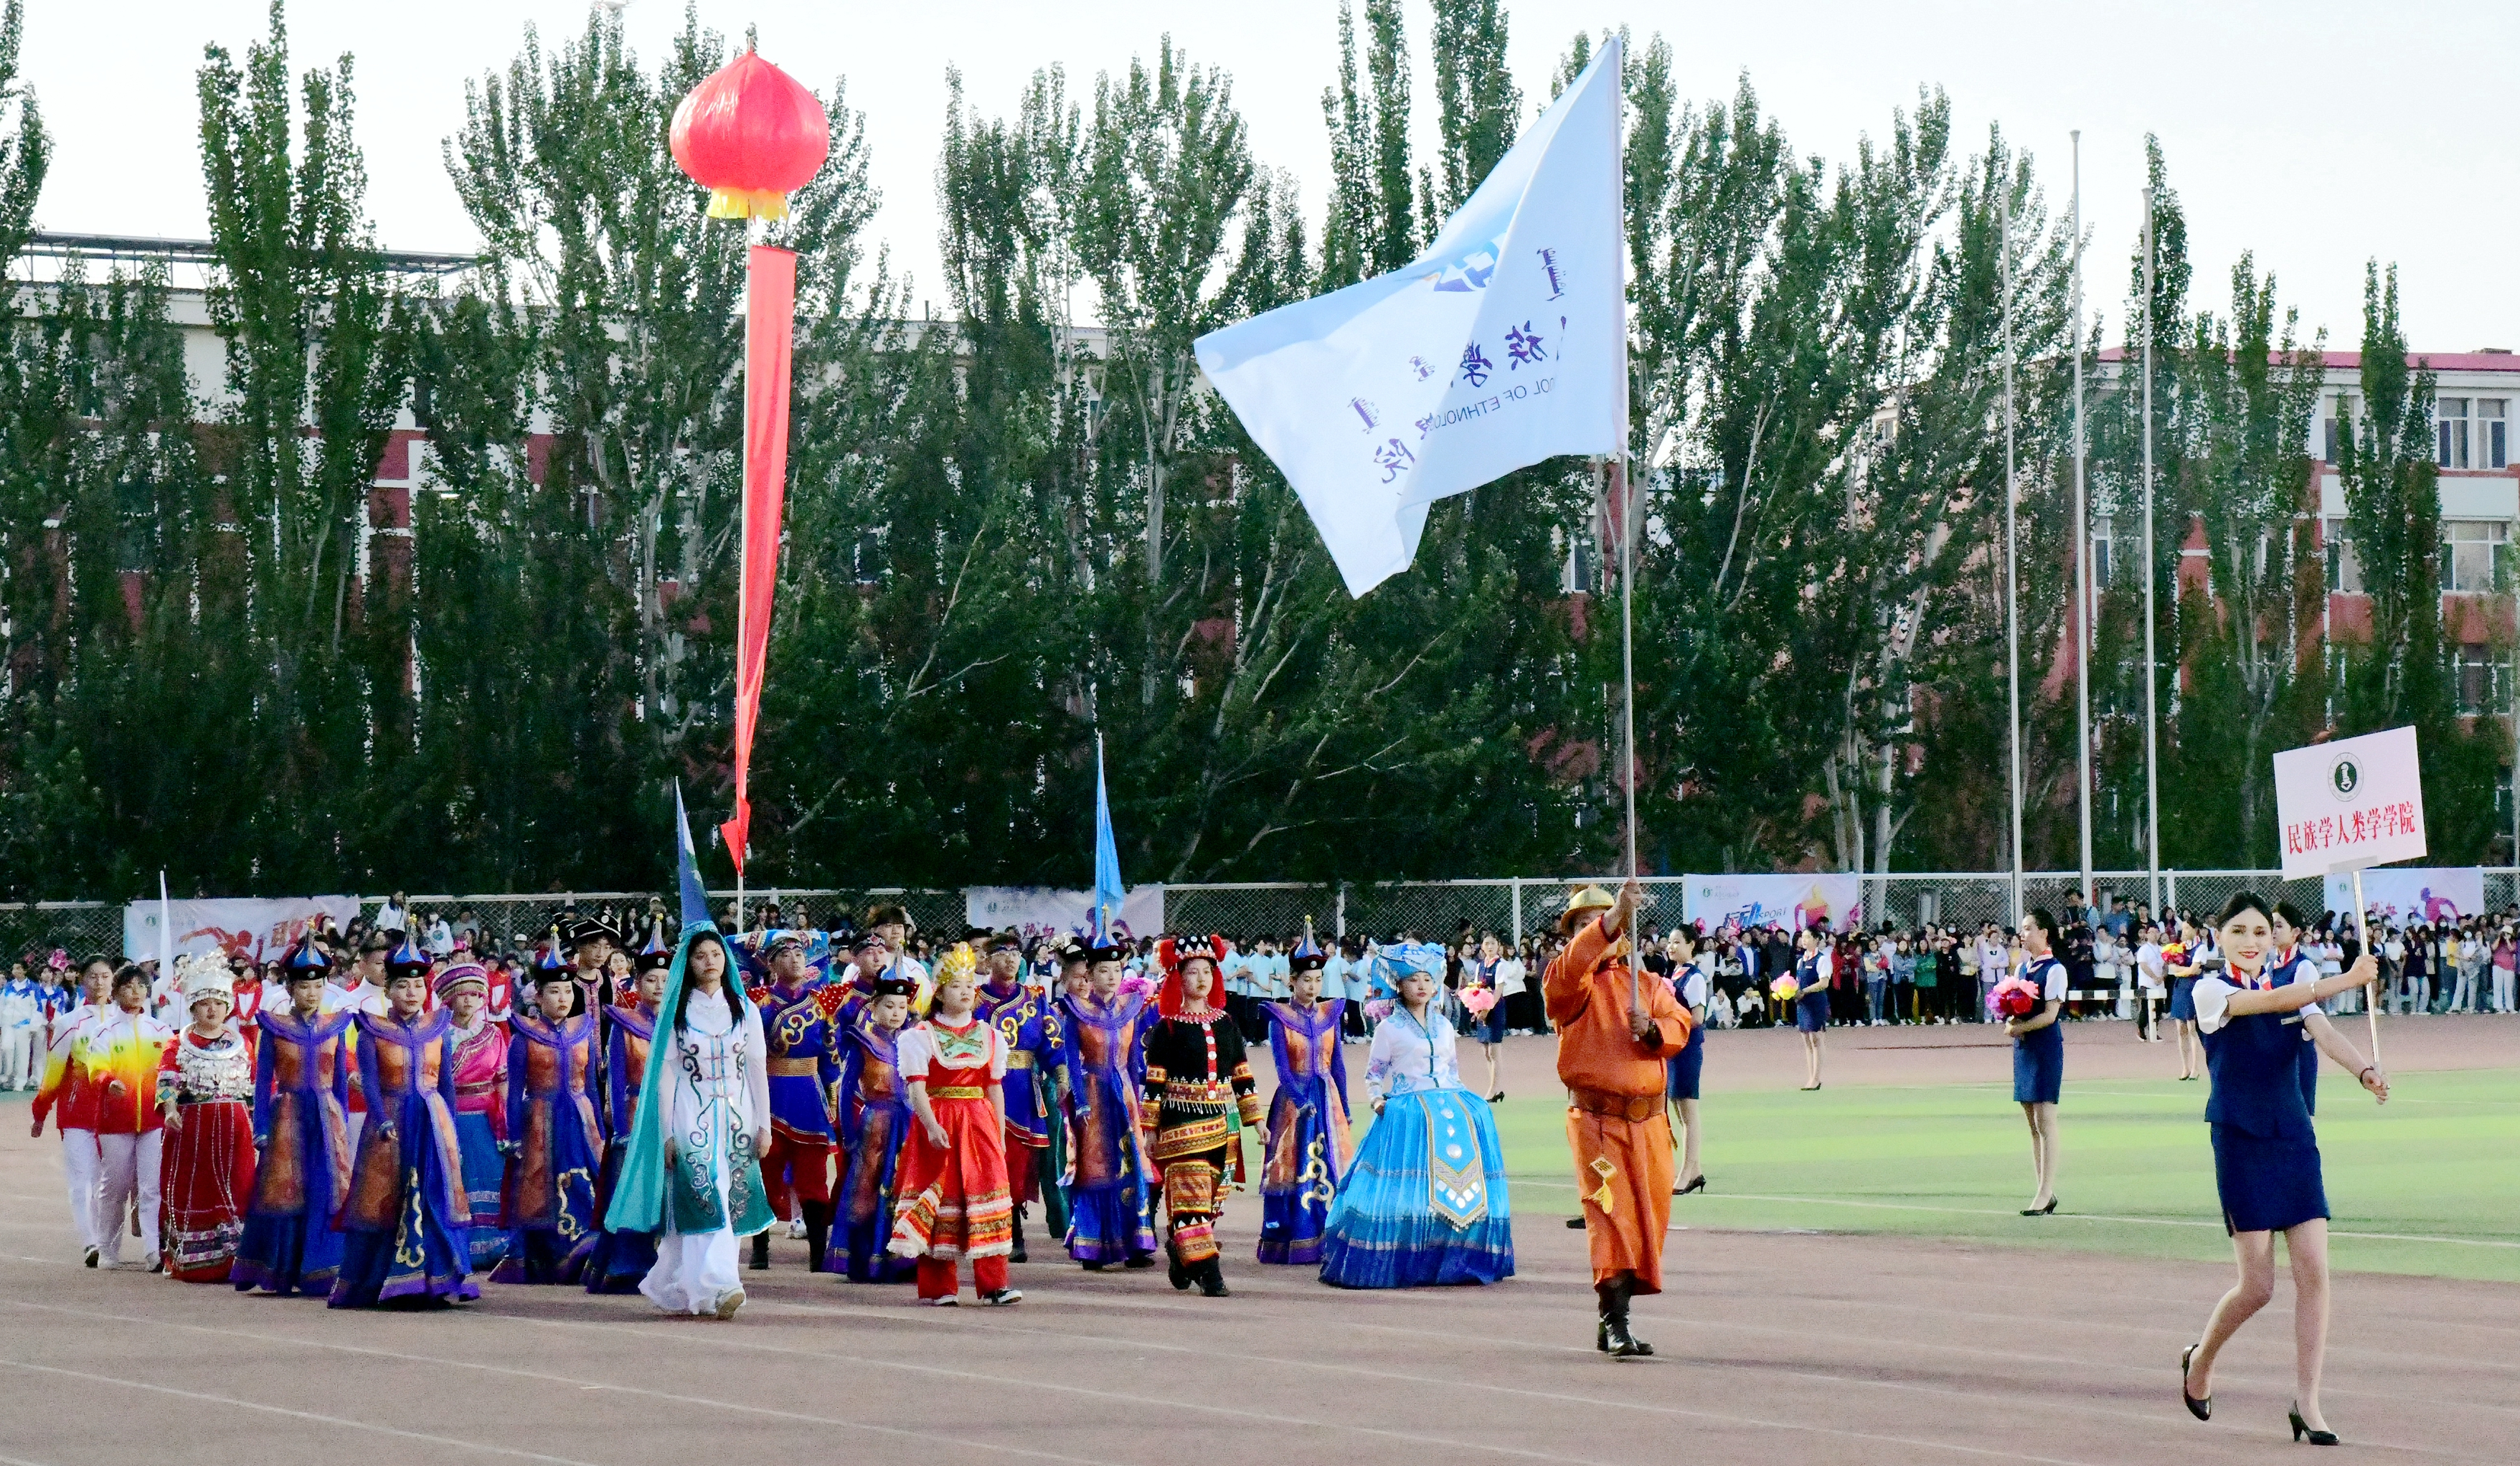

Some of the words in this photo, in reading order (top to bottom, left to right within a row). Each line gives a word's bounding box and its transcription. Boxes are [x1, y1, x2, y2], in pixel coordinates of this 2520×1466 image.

[2288, 801, 2415, 855] 民族学人类学学院
[1759, 907, 1788, 920] SPORT
